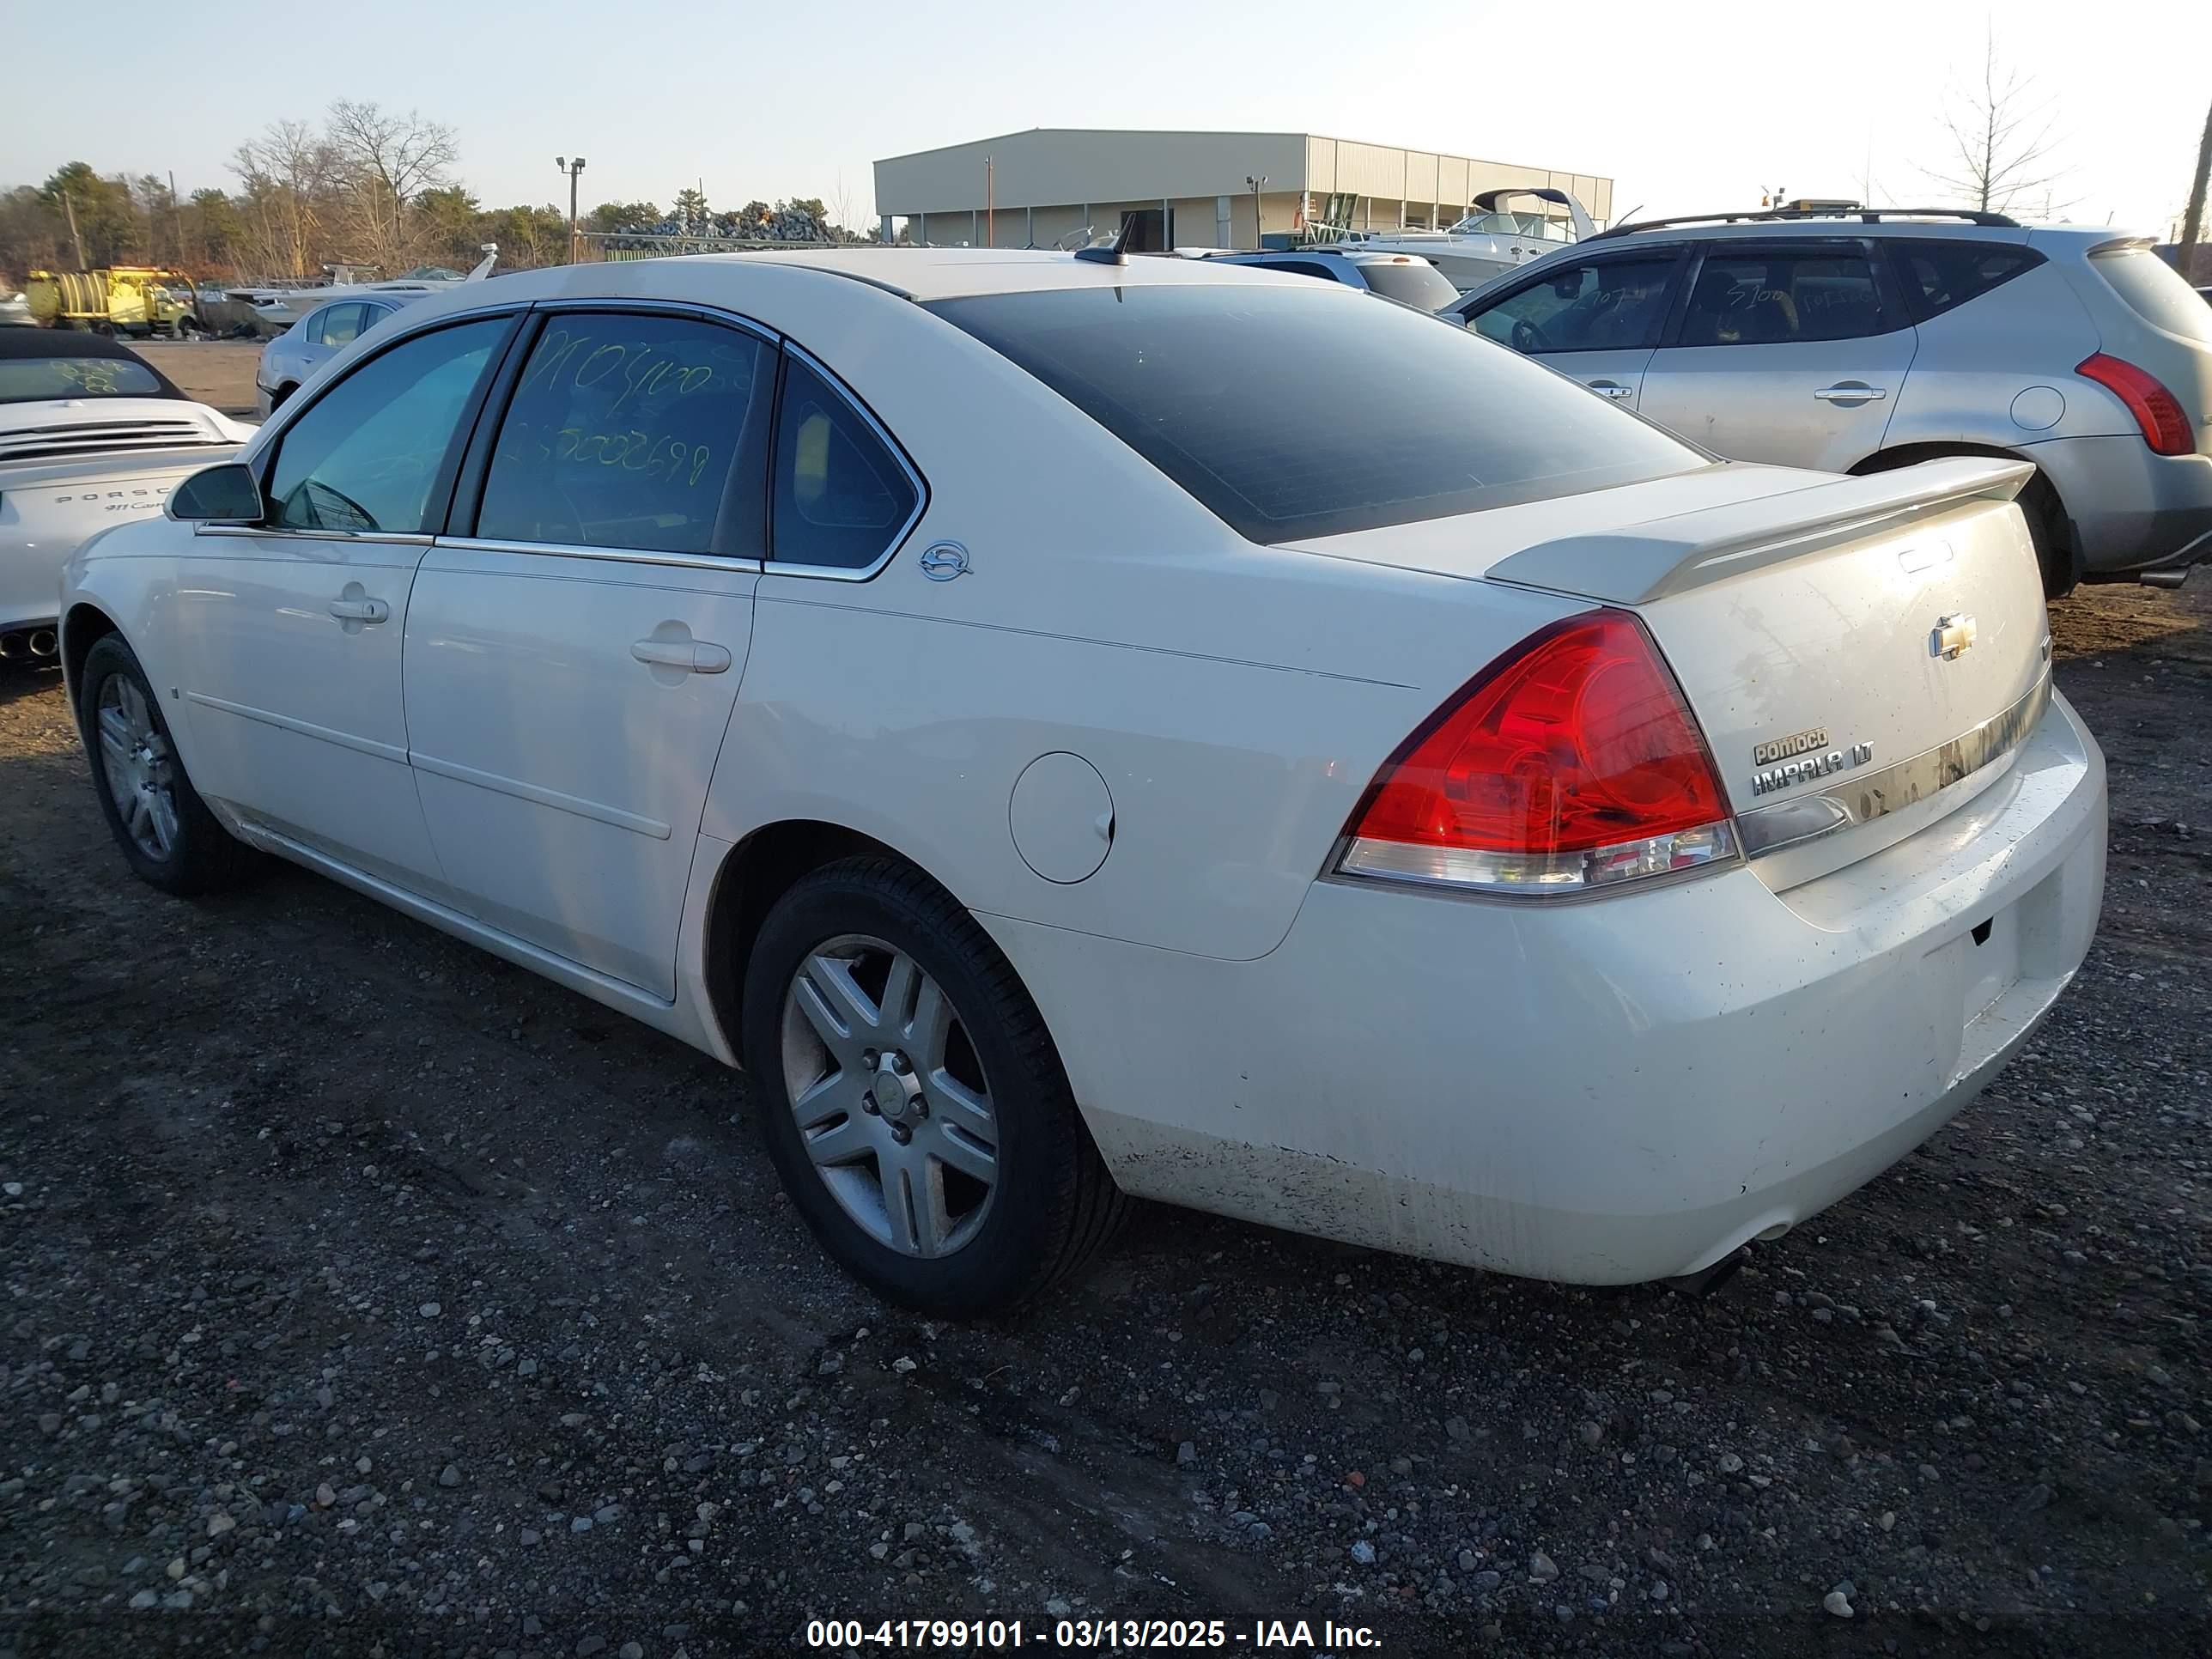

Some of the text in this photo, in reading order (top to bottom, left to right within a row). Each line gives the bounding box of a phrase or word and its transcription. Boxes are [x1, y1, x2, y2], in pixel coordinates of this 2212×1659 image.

[55, 488, 171, 503] PORSC
[1753, 740, 1875, 796] IMPALA LT
